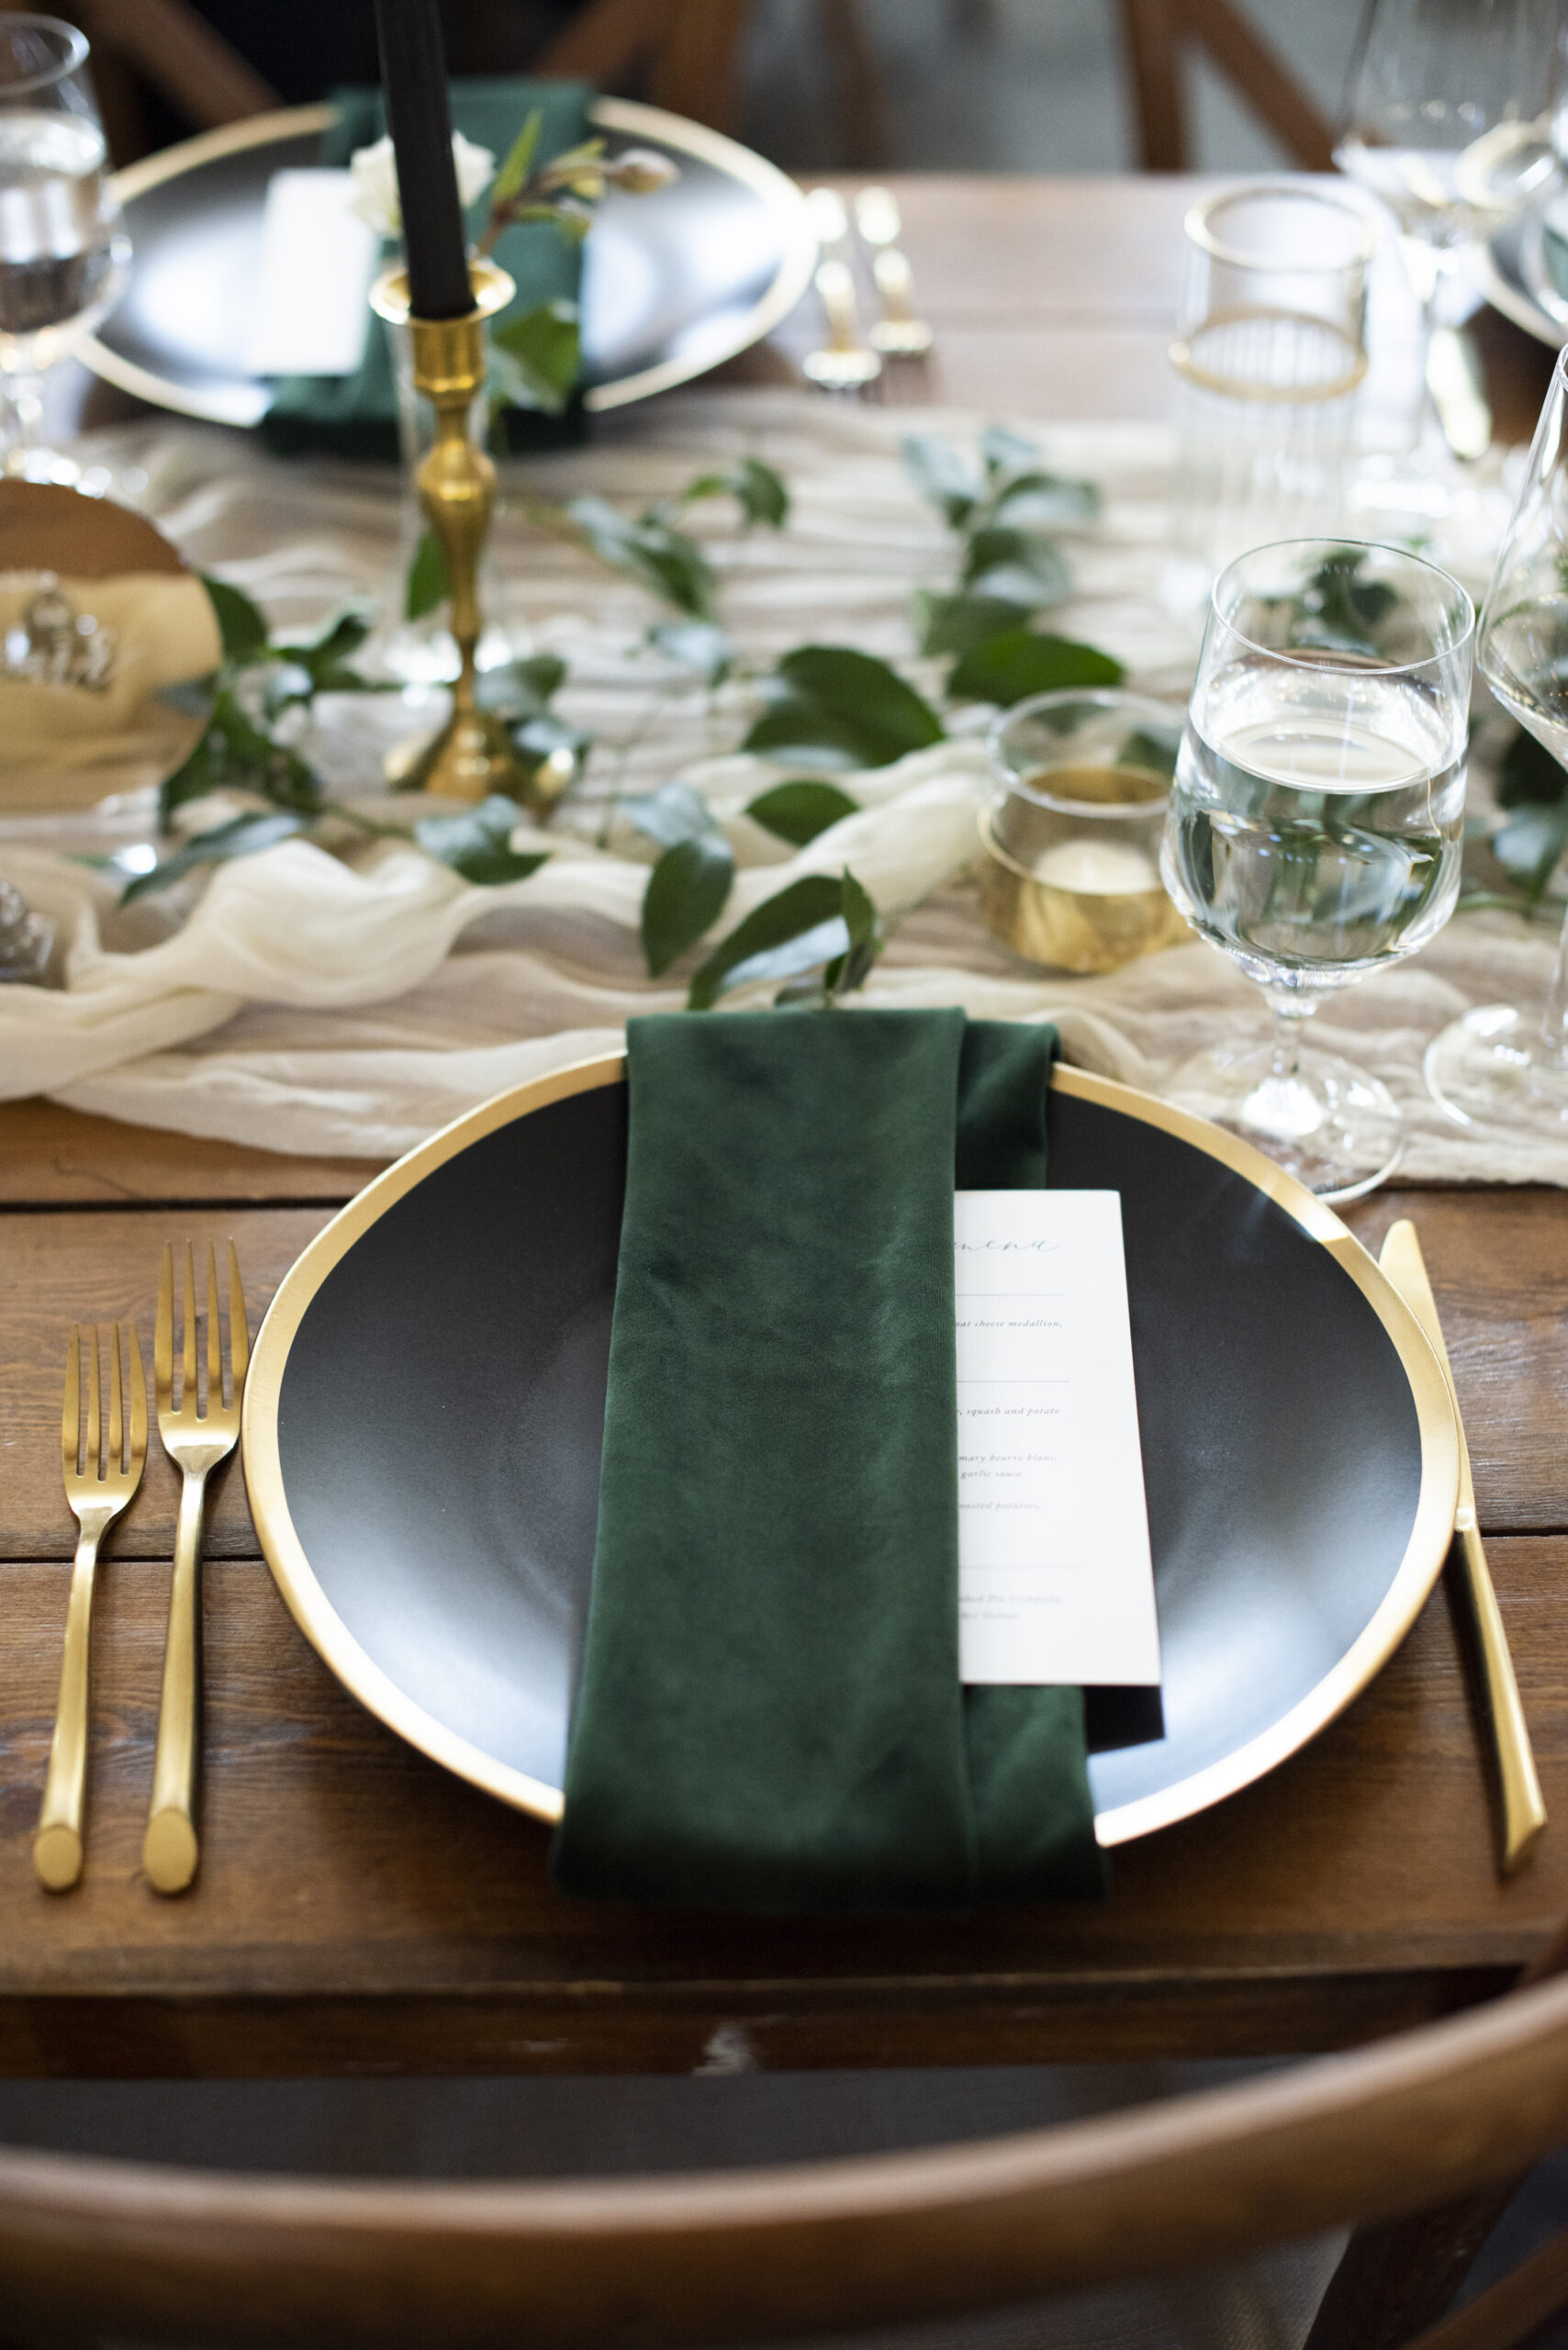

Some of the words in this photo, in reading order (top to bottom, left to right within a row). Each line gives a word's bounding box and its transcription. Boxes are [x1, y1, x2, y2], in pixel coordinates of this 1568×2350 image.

[974, 1319, 1005, 1328] cheese
[967, 1407, 1001, 1417] squash
[1004, 1406, 1025, 1416] and
[1026, 1407, 1060, 1417] potato
[990, 1453, 1024, 1462] beurre
[960, 1469, 991, 1480] garlic
